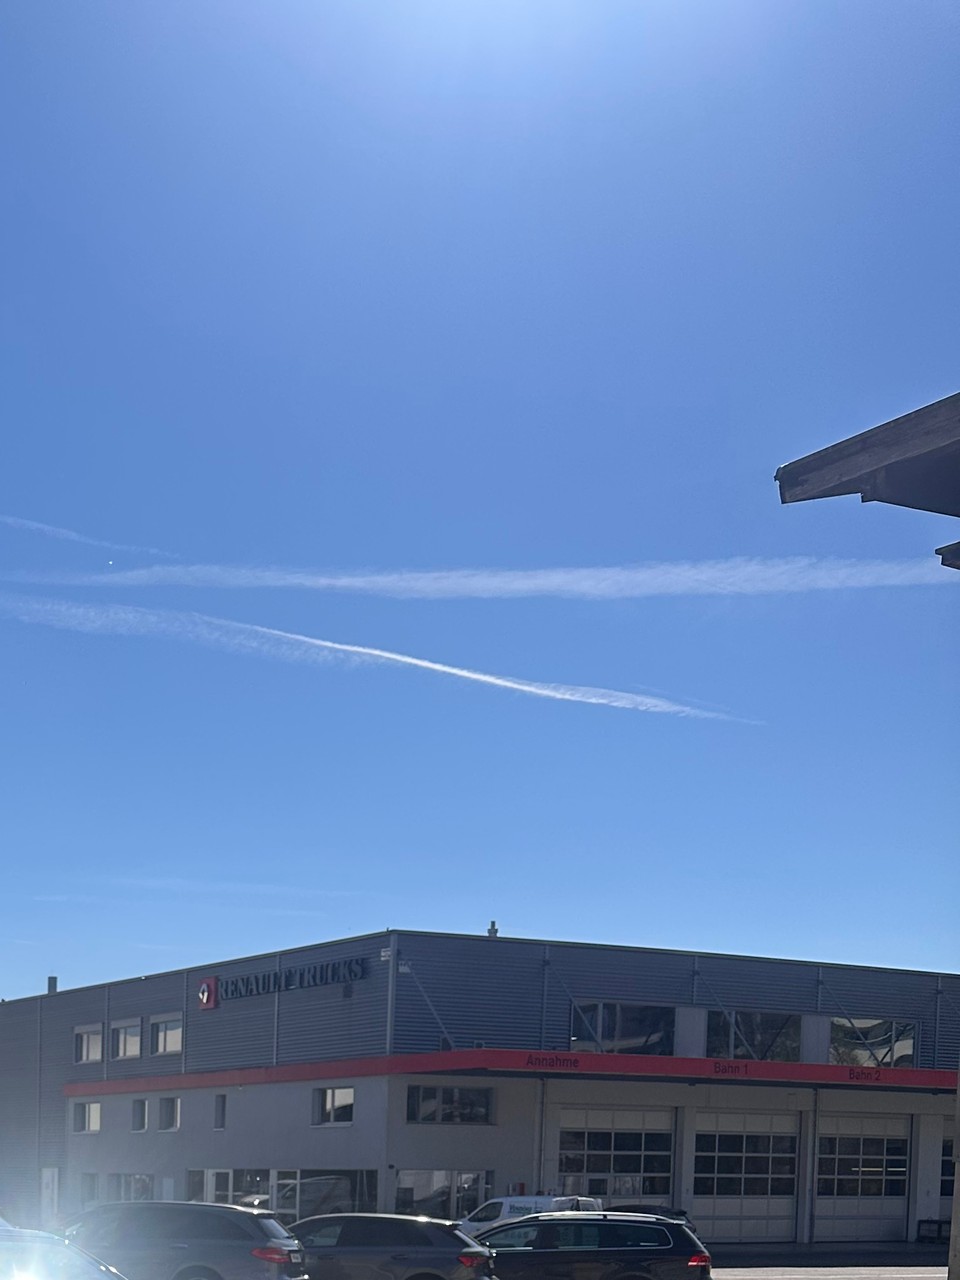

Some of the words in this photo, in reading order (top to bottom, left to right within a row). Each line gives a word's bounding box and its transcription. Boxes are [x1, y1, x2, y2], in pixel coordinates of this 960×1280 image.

[219, 969, 290, 1000] RENAULT
[293, 959, 366, 989] TRUCKS
[526, 1054, 580, 1068] Annahme
[713, 1062, 740, 1075] Bahn
[848, 1068, 873, 1081] Bahn
[874, 1070, 882, 1082] 2
